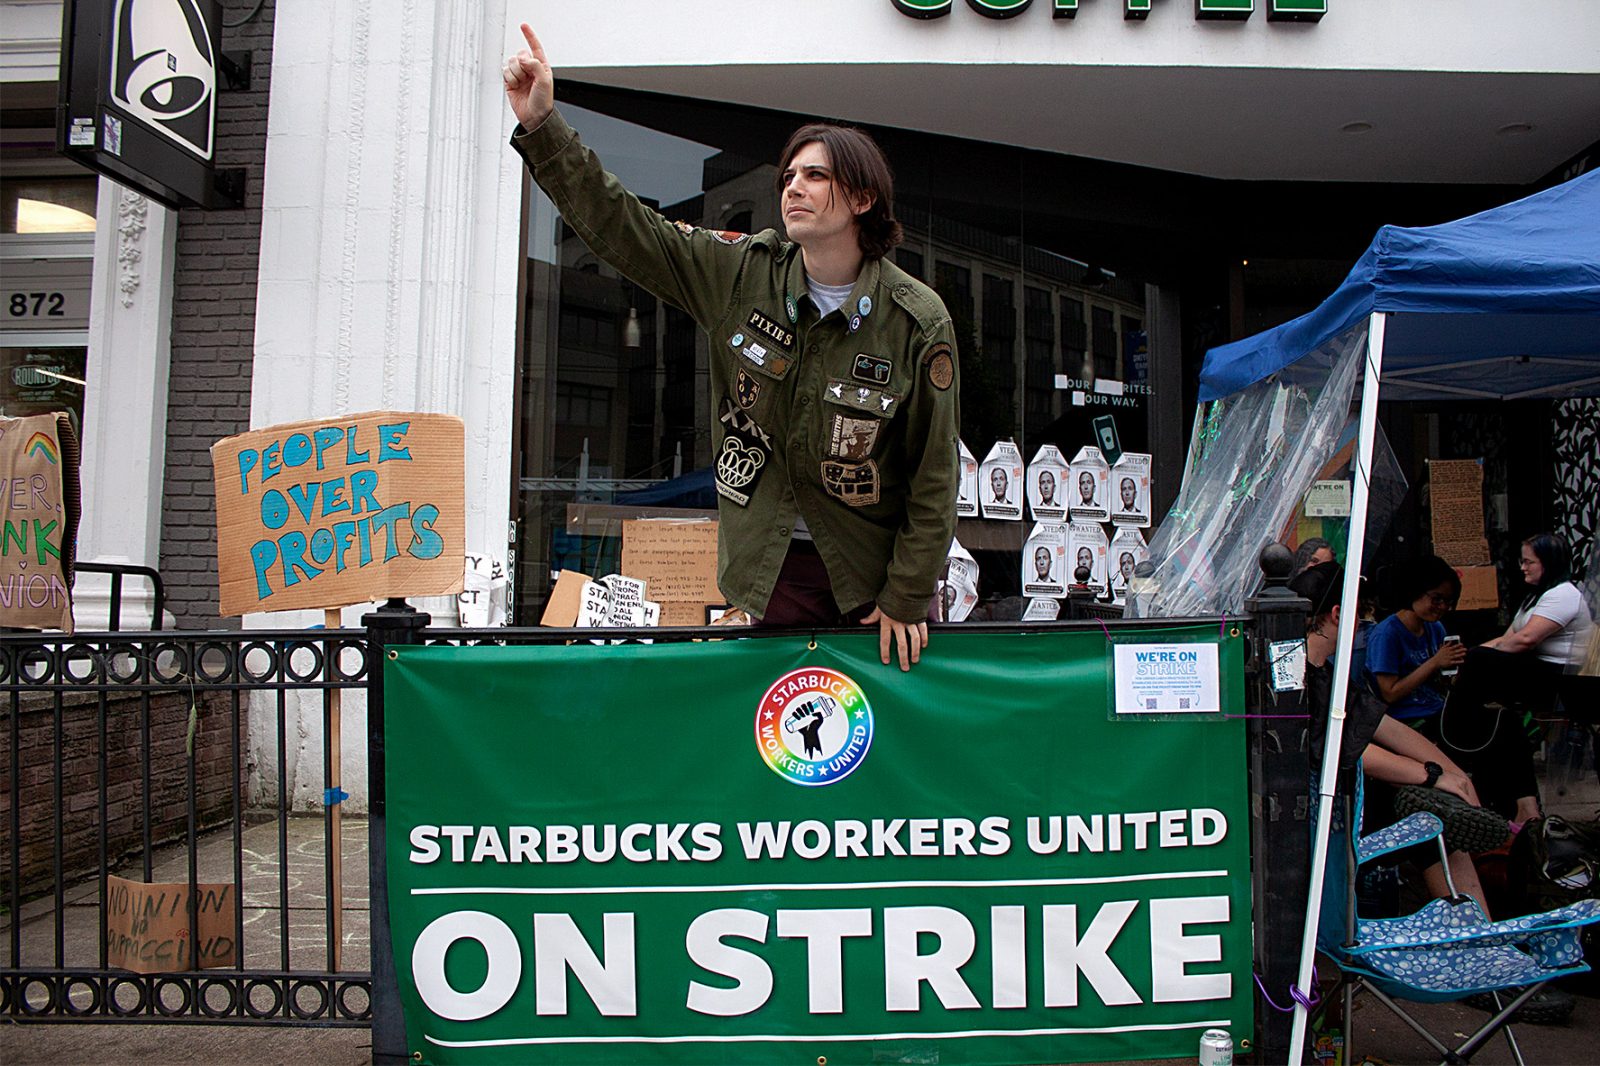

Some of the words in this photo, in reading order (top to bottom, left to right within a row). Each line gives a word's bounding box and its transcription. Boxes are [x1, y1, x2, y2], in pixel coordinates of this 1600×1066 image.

[9, 292, 65, 316] 872
[749, 312, 793, 346] PIXIES
[1111, 396, 1139, 408] WAY.
[833, 414, 843, 441] SMITHS
[238, 420, 413, 496] PEOPLE
[831, 441, 839, 456] THE
[260, 469, 384, 531] OVER
[0, 518, 61, 566] NK
[509, 522, 516, 542] NO
[249, 501, 445, 601] PROFITS
[1135, 651, 1176, 662] WE'RE
[1178, 651, 1197, 662] ON
[1136, 662, 1197, 675] STRIKE
[772, 675, 858, 707] STARBUCKS
[762, 724, 815, 777] WORKERS
[829, 725, 866, 772] UNITED
[409, 822, 723, 865] STARBUCKS
[736, 816, 1011, 860] WORKERS
[1027, 808, 1227, 855] UNITED
[108, 885, 128, 917] NO
[411, 910, 637, 1021] ON
[685, 895, 1233, 1017] STRIKE
